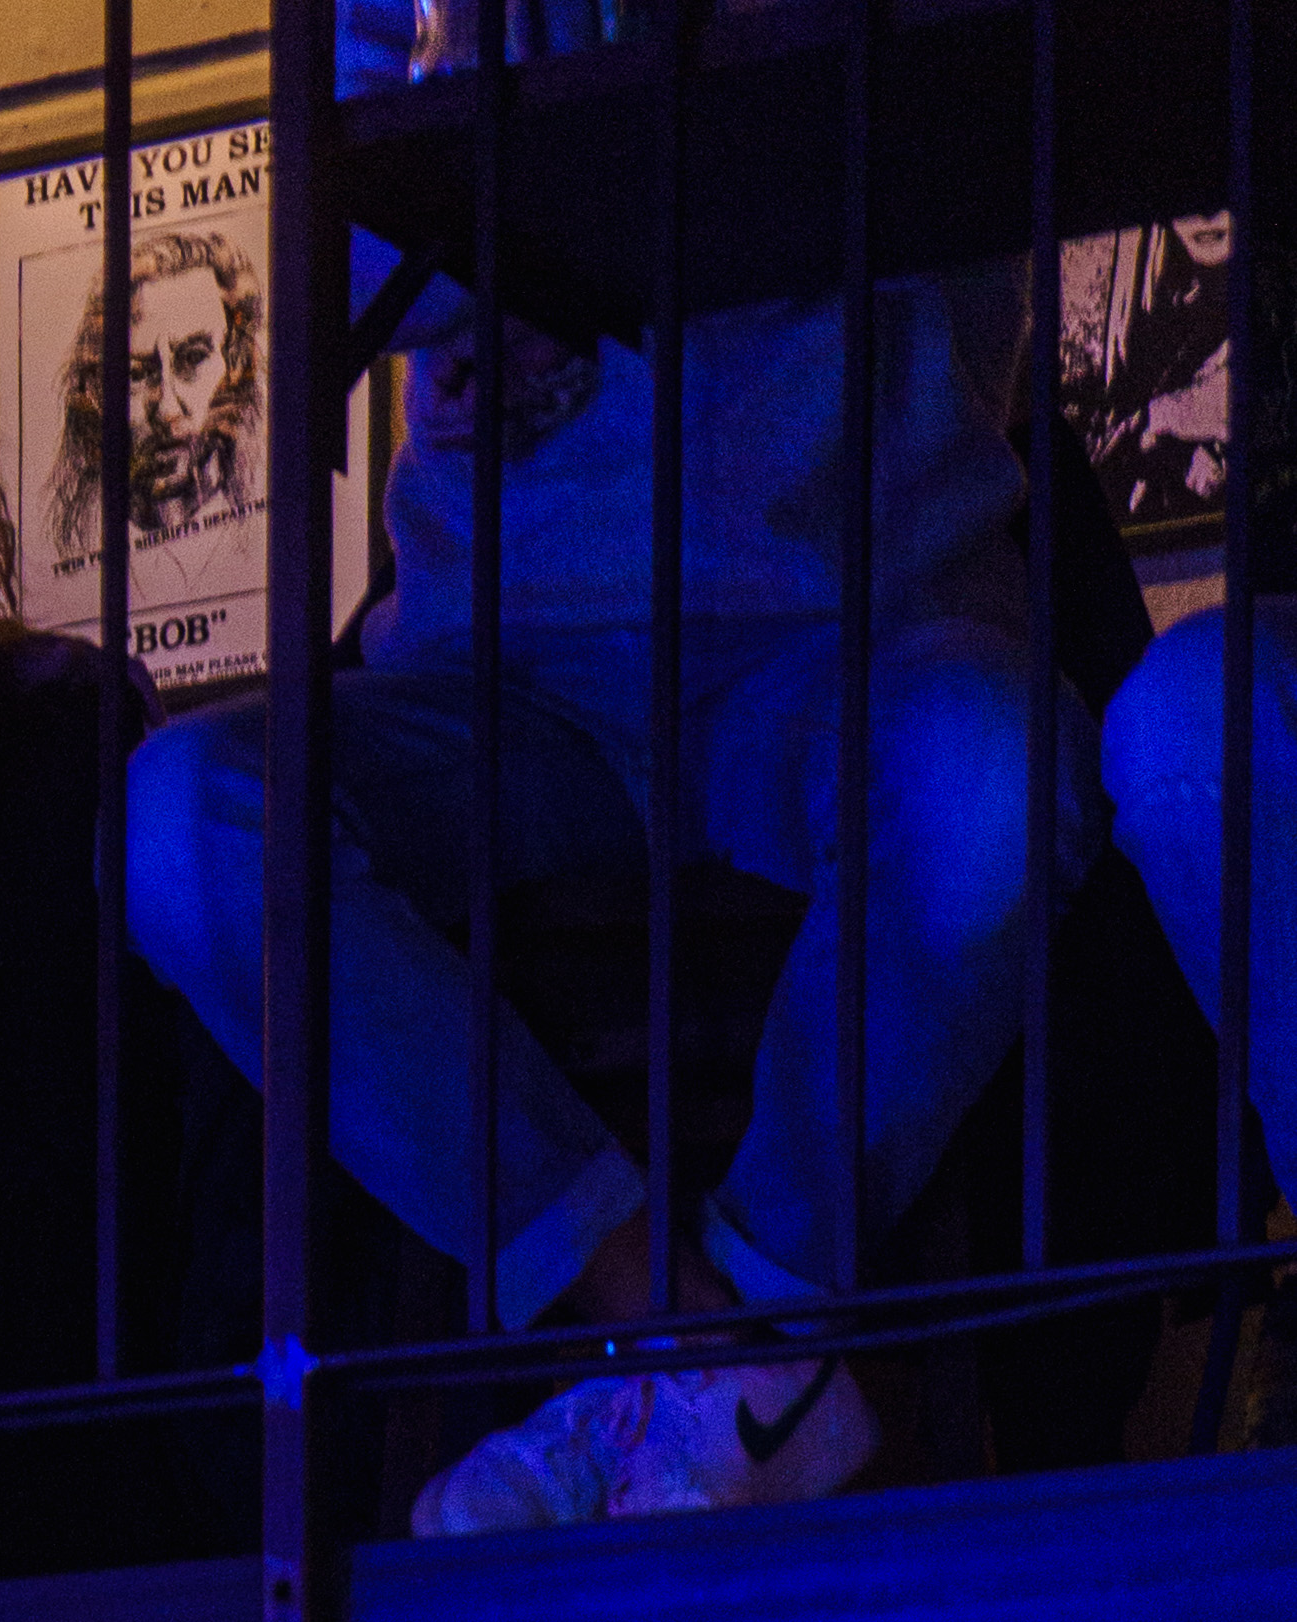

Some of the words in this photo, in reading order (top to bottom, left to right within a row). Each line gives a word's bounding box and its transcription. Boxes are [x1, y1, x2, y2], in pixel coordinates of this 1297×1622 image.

[25, 164, 117, 205] HAV
[137, 138, 213, 179] YOU
[79, 185, 166, 230] TIS
